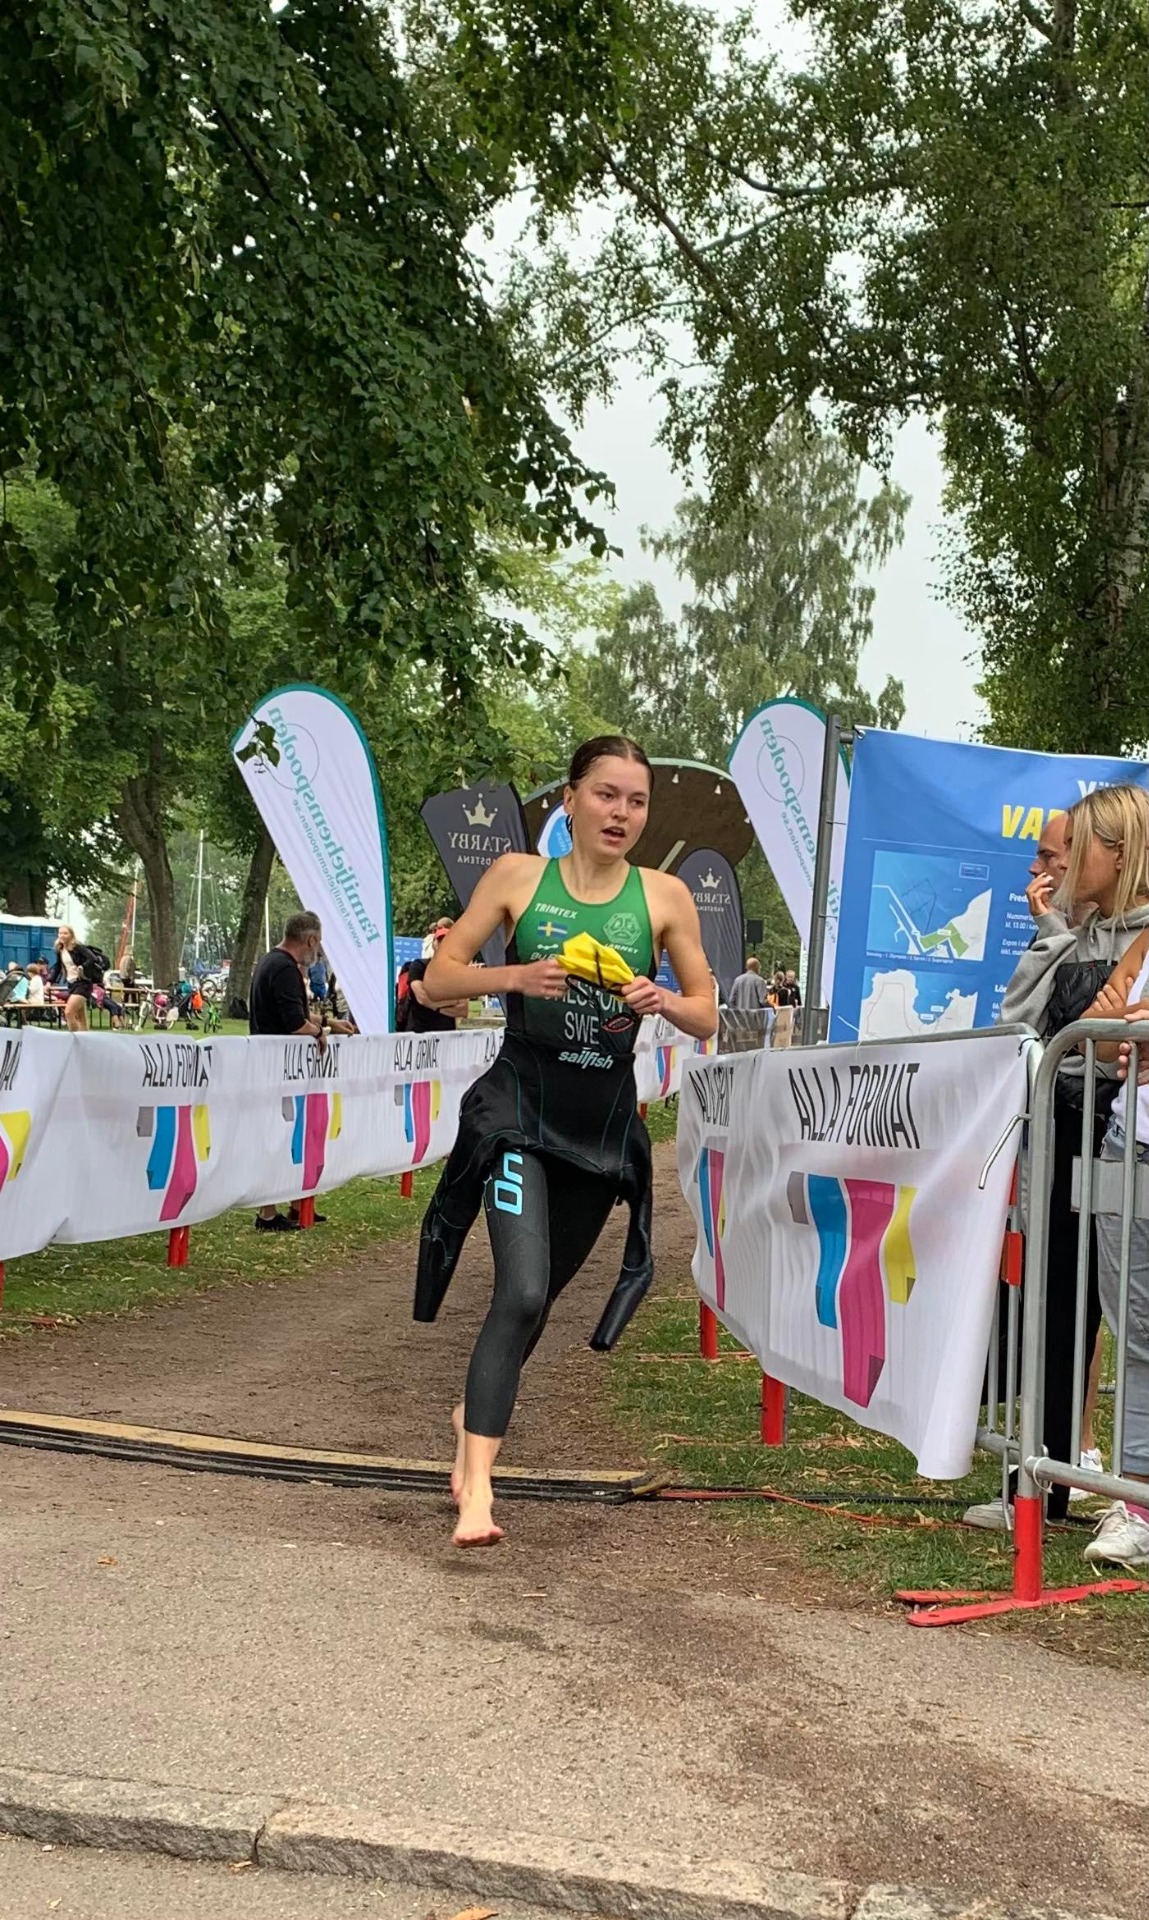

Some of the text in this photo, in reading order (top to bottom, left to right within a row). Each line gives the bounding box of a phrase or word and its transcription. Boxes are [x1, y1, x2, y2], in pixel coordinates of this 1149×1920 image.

[534, 903, 578, 919] TRIMTEX
[564, 1011, 600, 1044] SWE
[139, 1043, 173, 1087] ALLA
[558, 1048, 614, 1069] sailfish
[788, 1065, 842, 1143] ALLA
[846, 1063, 921, 1149] FORMAT
